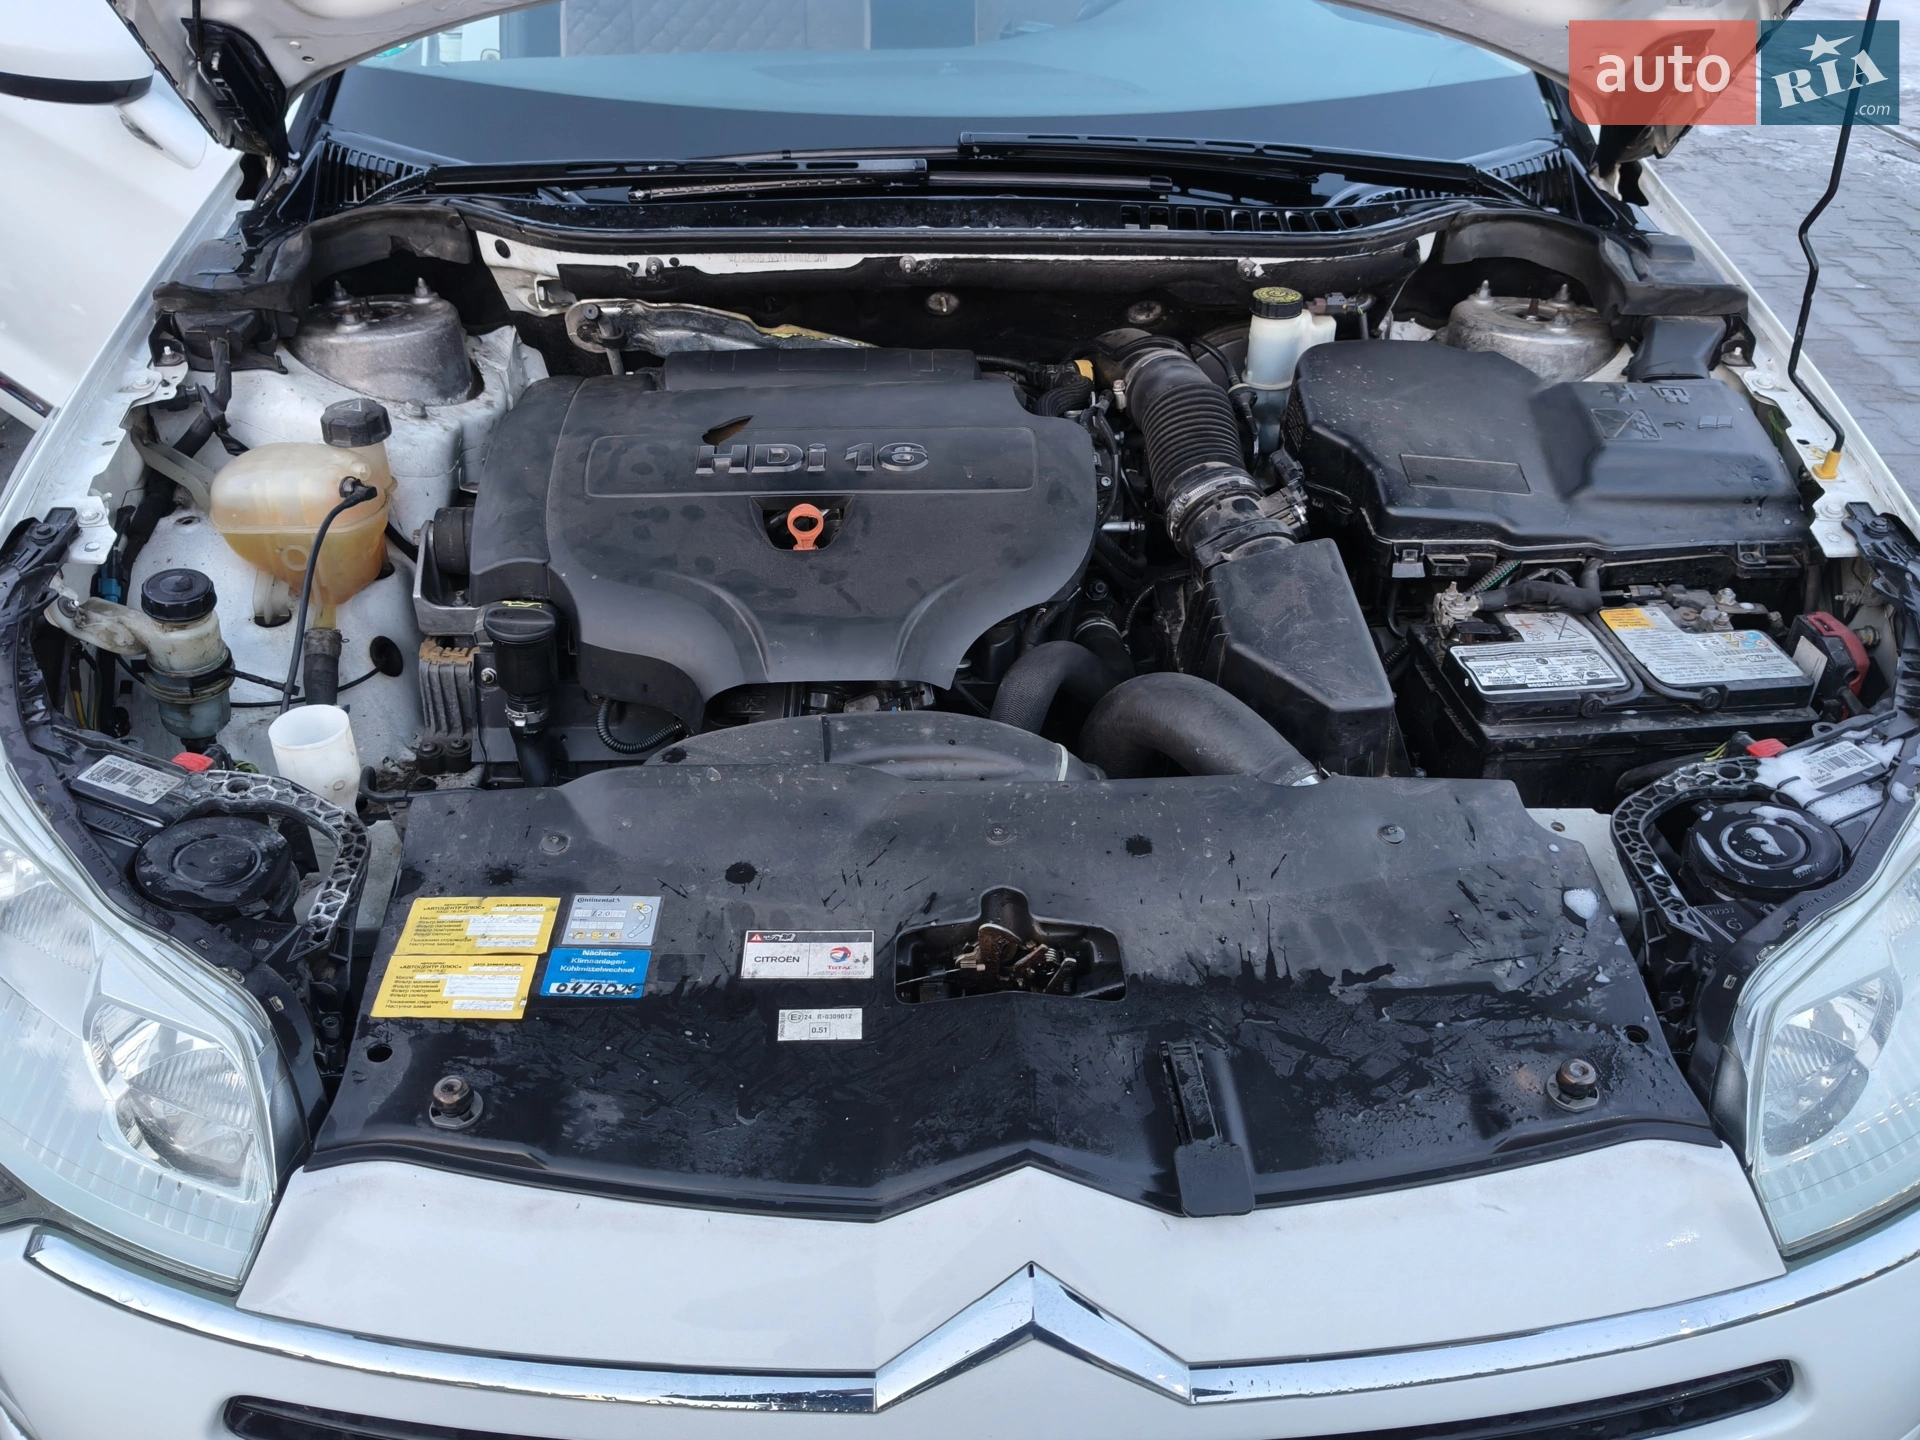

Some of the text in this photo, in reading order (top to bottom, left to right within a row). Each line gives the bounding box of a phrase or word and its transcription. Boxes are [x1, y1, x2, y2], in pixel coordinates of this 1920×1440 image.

[695, 442, 929, 475] HDi 16
[754, 954, 800, 963] CITROËN
[560, 965, 636, 973] Kühlmittelwechsel
